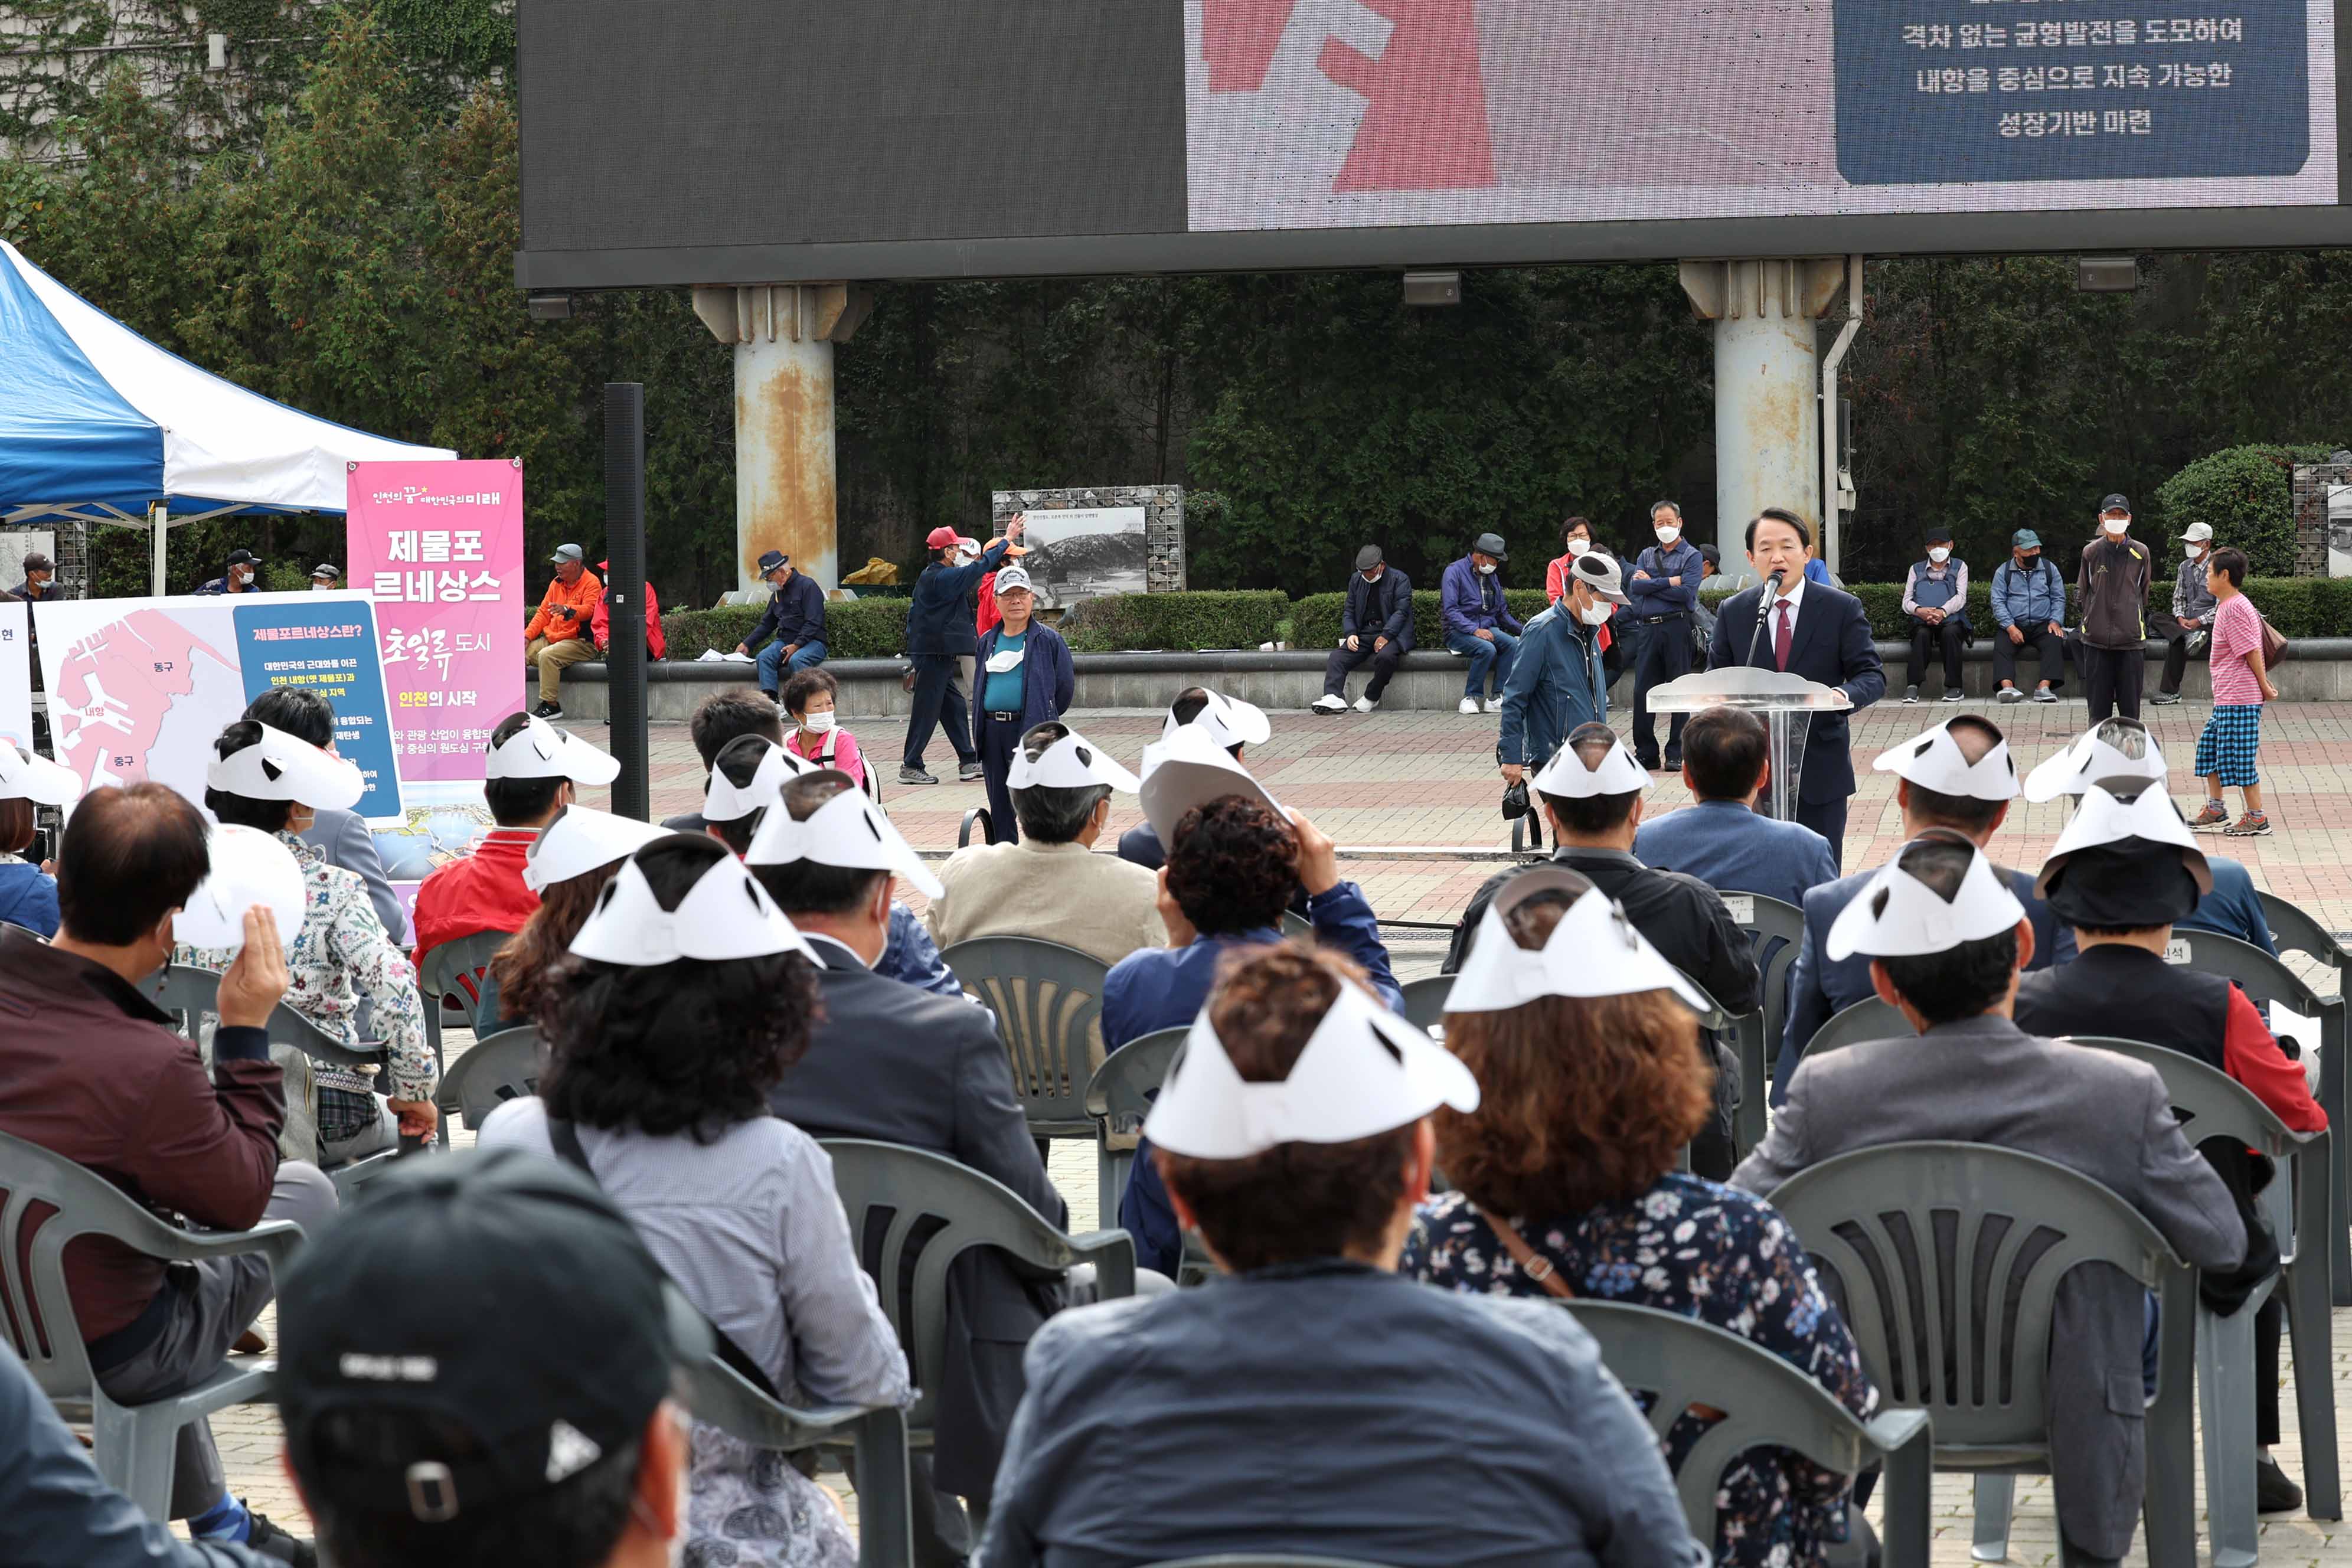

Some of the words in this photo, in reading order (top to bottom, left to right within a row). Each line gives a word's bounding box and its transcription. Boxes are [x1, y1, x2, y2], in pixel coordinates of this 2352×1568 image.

[1903, 24, 1952, 49] 격차
[1958, 22, 2007, 48] 없는
[2014, 20, 2138, 48] 균형발전을
[2144, 17, 2243, 45] 도모하여
[1916, 68, 1990, 93] 내항을
[1997, 65, 2096, 92] 중심으로
[2102, 64, 2150, 89] 지속
[2158, 62, 2232, 88] 가능한
[1998, 113, 2097, 137] 성장기반
[2103, 110, 2151, 135] 마련
[373, 491, 402, 504] 인천의
[404, 486, 422, 504] 꿈
[388, 530, 484, 563] 제물포
[374, 570, 501, 603] 르네상스
[253, 625, 362, 641] 제물포르네상스란?
[384, 627, 453, 682] 초일류
[455, 633, 491, 652] 도시
[154, 662, 174, 672] 동구
[264, 661, 305, 671] 대한민국의
[307, 659, 339, 669] 근대화를
[341, 658, 357, 668] 이끈
[271, 676, 287, 685] 인천
[329, 688, 345, 697] 지역
[399, 691, 442, 707] 인천의
[447, 691, 477, 707] 시작
[85, 707, 104, 717] 내항
[340, 716, 373, 726] 융합되는
[335, 730, 360, 740] 재탄생
[407, 729, 426, 741] 관광
[430, 729, 459, 740] 산업이
[462, 729, 494, 740] 융합되
[407, 743, 436, 754] 중심의
[440, 743, 469, 754] 원도심
[114, 756, 134, 767] 중구
